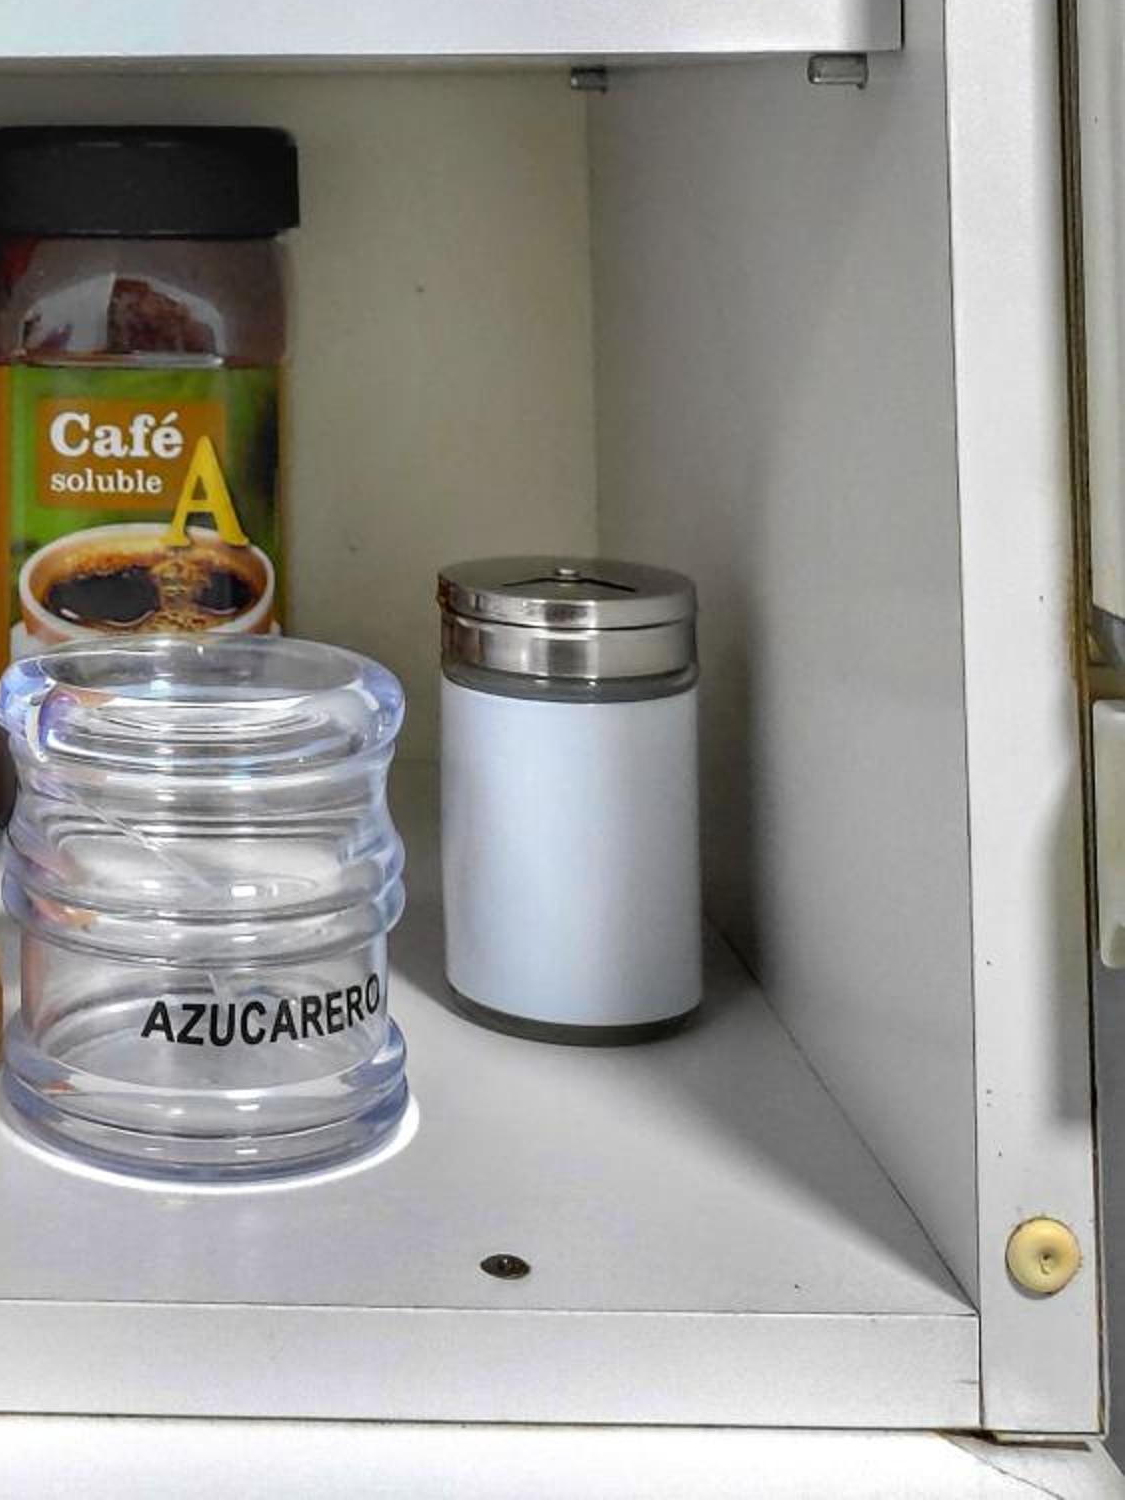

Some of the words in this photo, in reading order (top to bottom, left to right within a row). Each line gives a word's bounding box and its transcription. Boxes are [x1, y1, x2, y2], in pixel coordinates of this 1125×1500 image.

[50, 411, 183, 458] Café
[50, 468, 163, 493] soluble
[160, 435, 249, 547] A
[141, 973, 380, 1046] AZUCARERO
